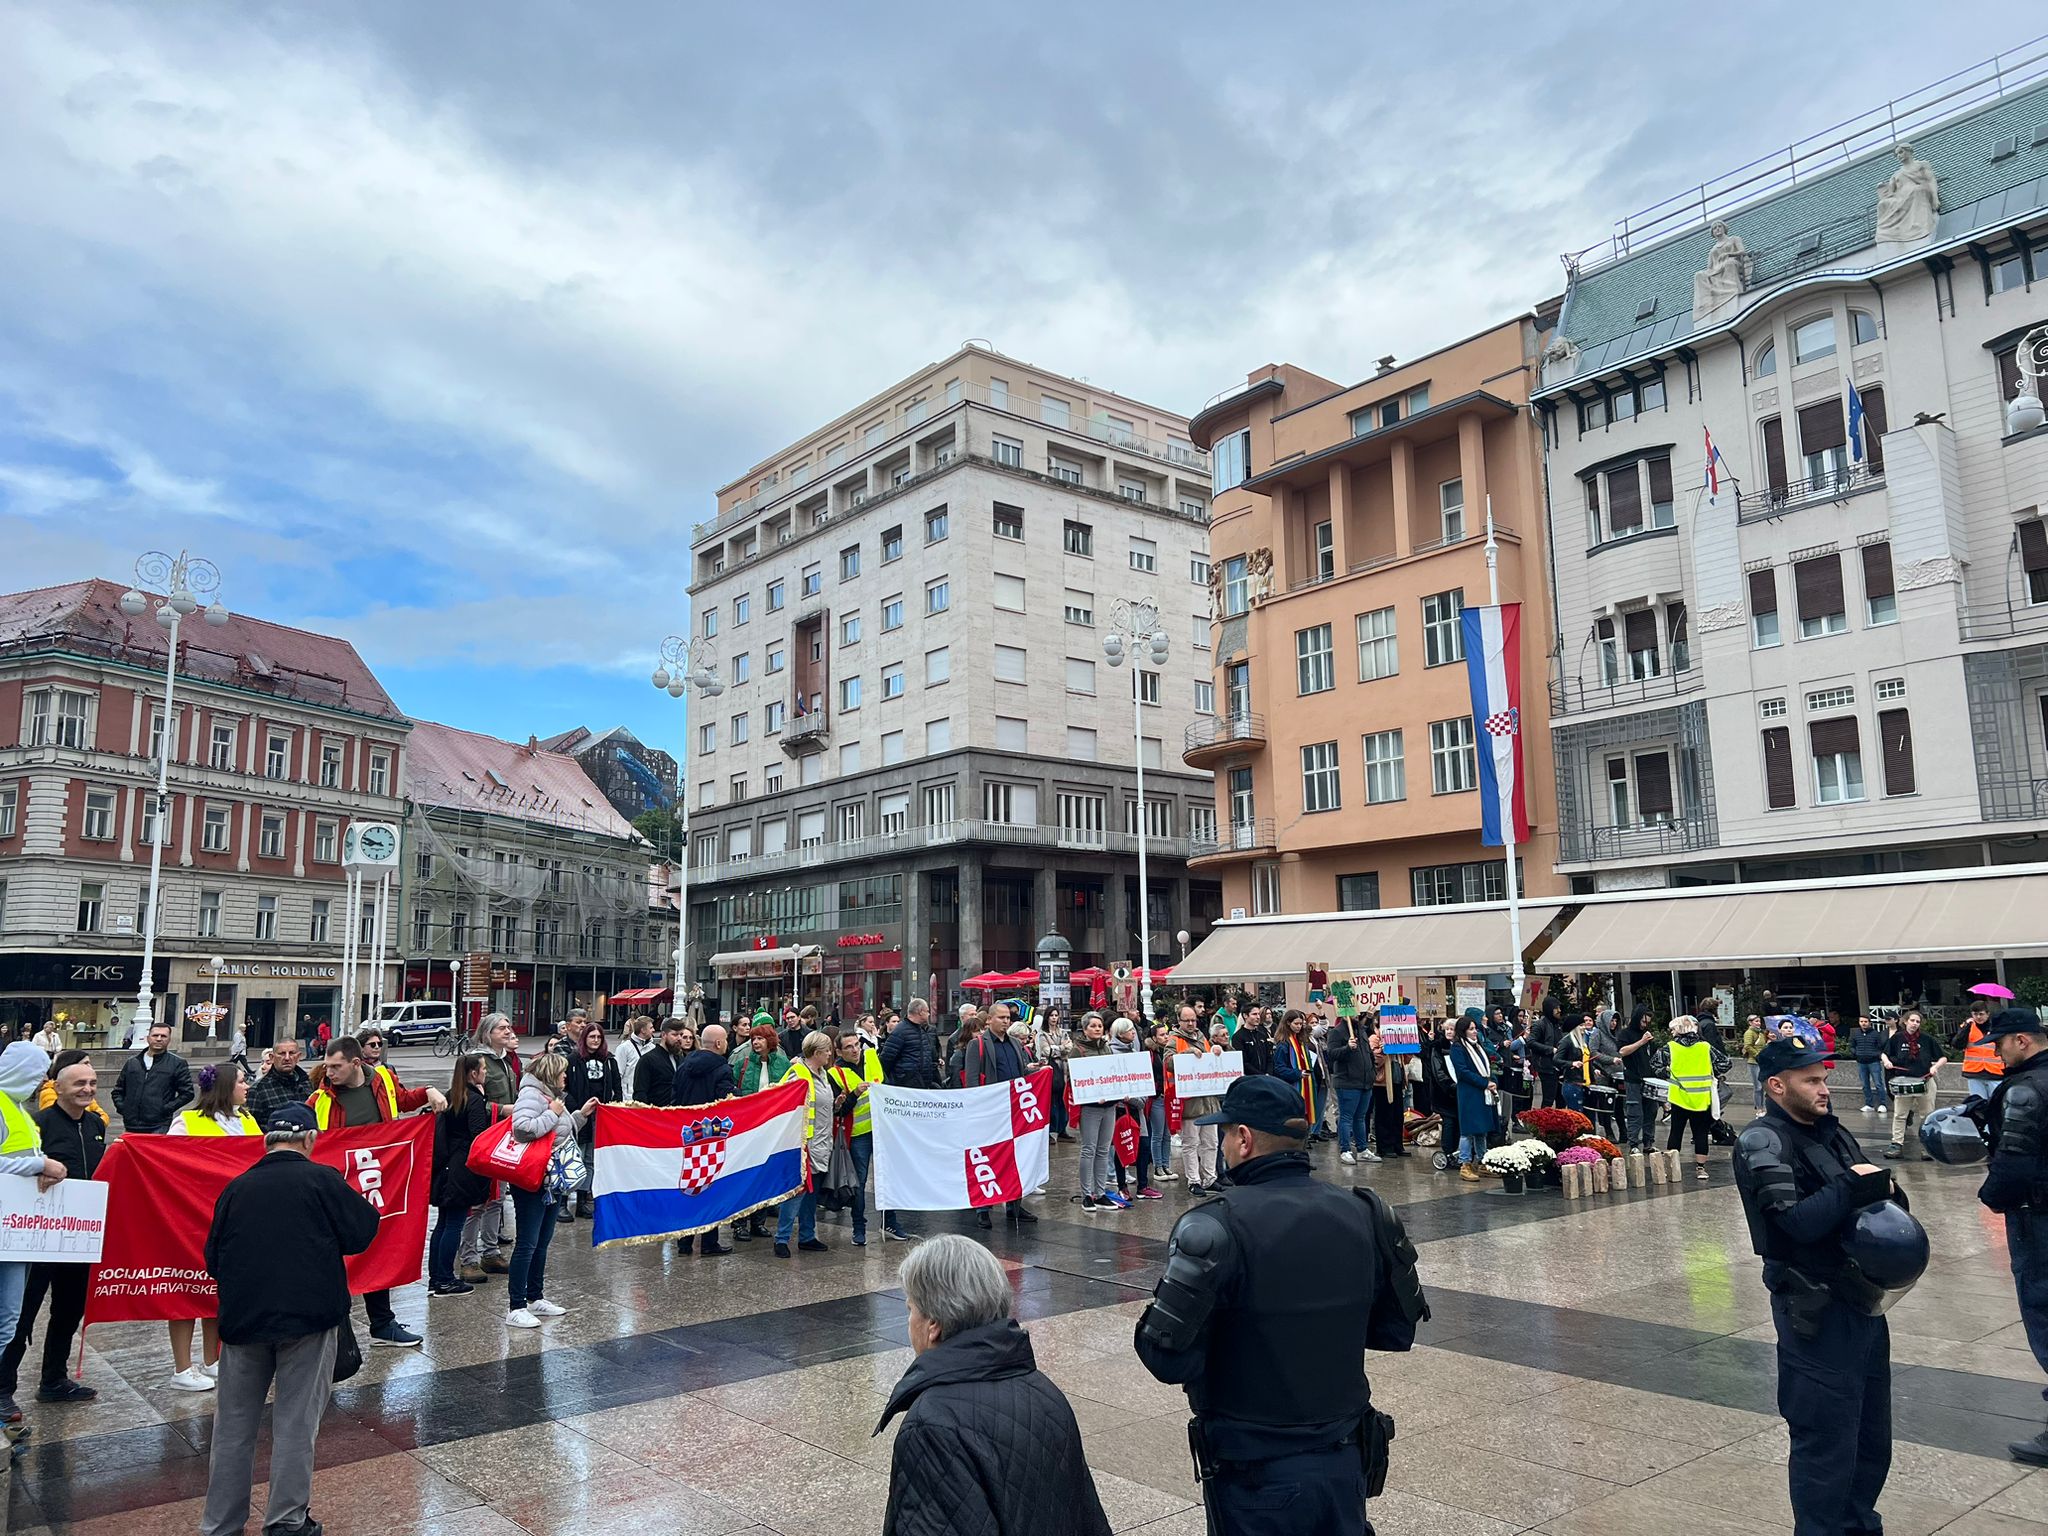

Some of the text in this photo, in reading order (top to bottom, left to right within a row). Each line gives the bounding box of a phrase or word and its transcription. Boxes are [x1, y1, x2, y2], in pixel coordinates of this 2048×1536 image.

[71, 964, 124, 980] ZAKS
[199, 963, 336, 977] AANIĆ HOLDING
[1073, 1077, 1095, 1088] Zagreb
[1177, 1073, 1194, 1082] Zagreb
[884, 1097, 964, 1109] SOCIJALDEMOKRATSKA
[1014, 1077, 1043, 1124] SDP
[884, 1107, 947, 1119] PARTIJA HRVATSKE
[969, 1147, 1002, 1199] SDP
[2, 1213, 102, 1232] #SafePlace4Women
[94, 1282, 218, 1298] PARTIJA HRVATSKE
